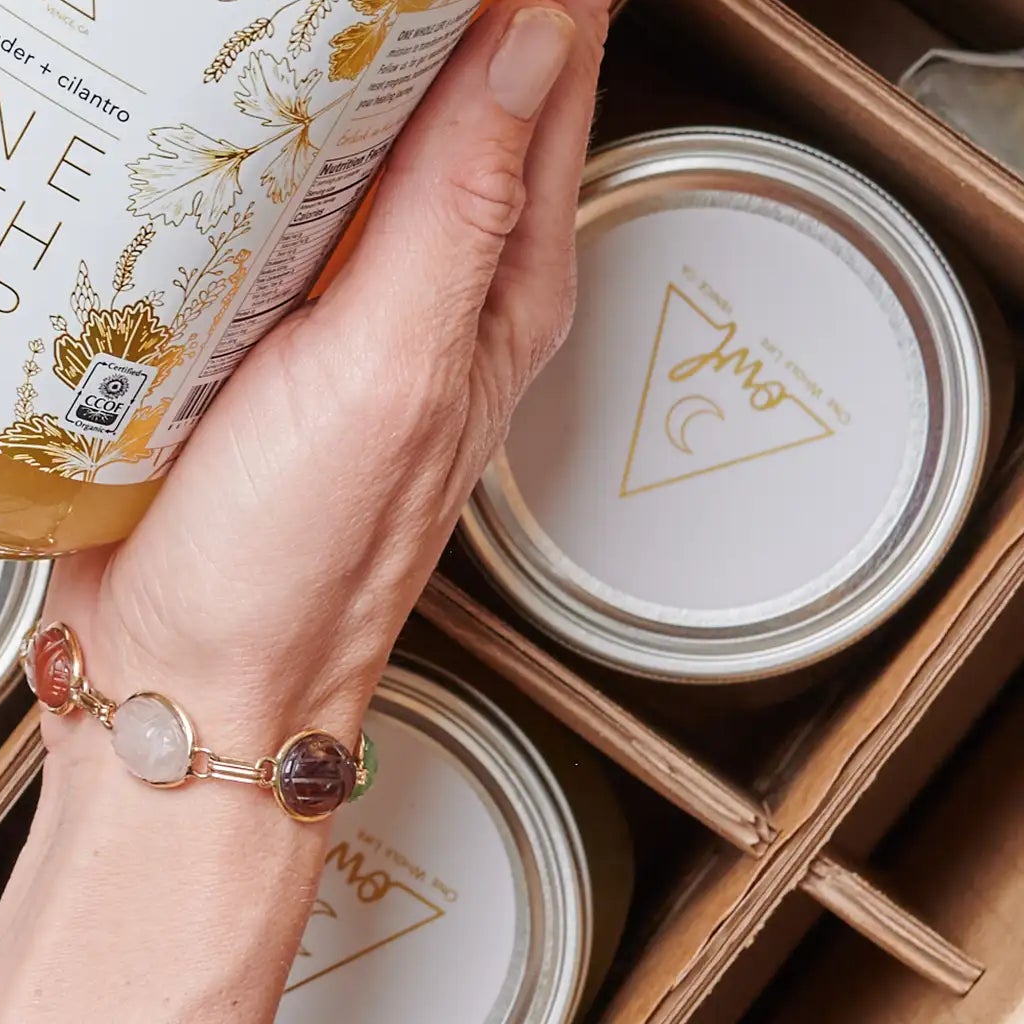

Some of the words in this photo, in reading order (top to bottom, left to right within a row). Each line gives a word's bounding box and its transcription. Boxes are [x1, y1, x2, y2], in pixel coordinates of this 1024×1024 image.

[57, 74, 131, 124] cilantro
[319, 156, 365, 176] Nutrition
[293, 208, 325, 222] Calories
[107, 362, 143, 377] Certified
[668, 321, 786, 411] owl
[85, 394, 125, 414] CCOF
[75, 420, 107, 435] Organic
